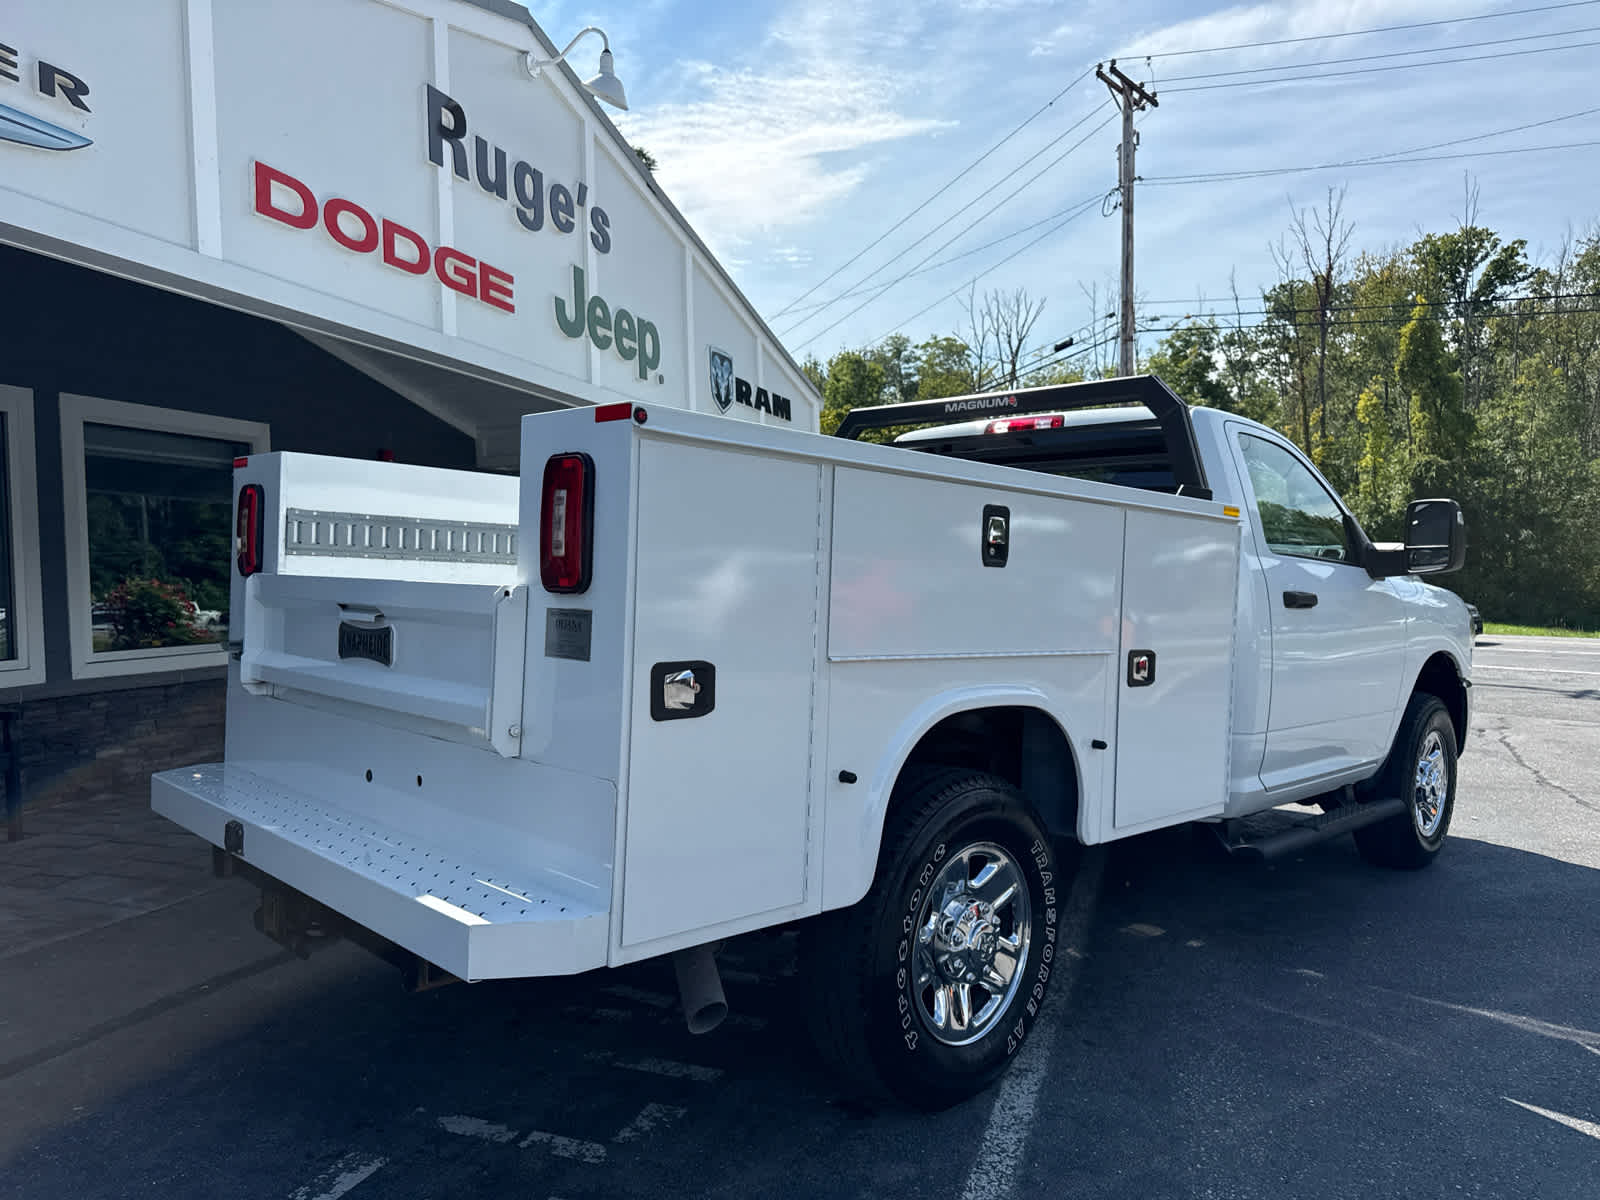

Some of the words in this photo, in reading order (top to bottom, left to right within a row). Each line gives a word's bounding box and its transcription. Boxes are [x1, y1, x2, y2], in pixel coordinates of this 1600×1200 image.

[426, 83, 612, 254] Ruge's
[254, 160, 516, 314] DODGE
[735, 376, 792, 422] RAM
[944, 395, 1008, 413] MAGNUM
